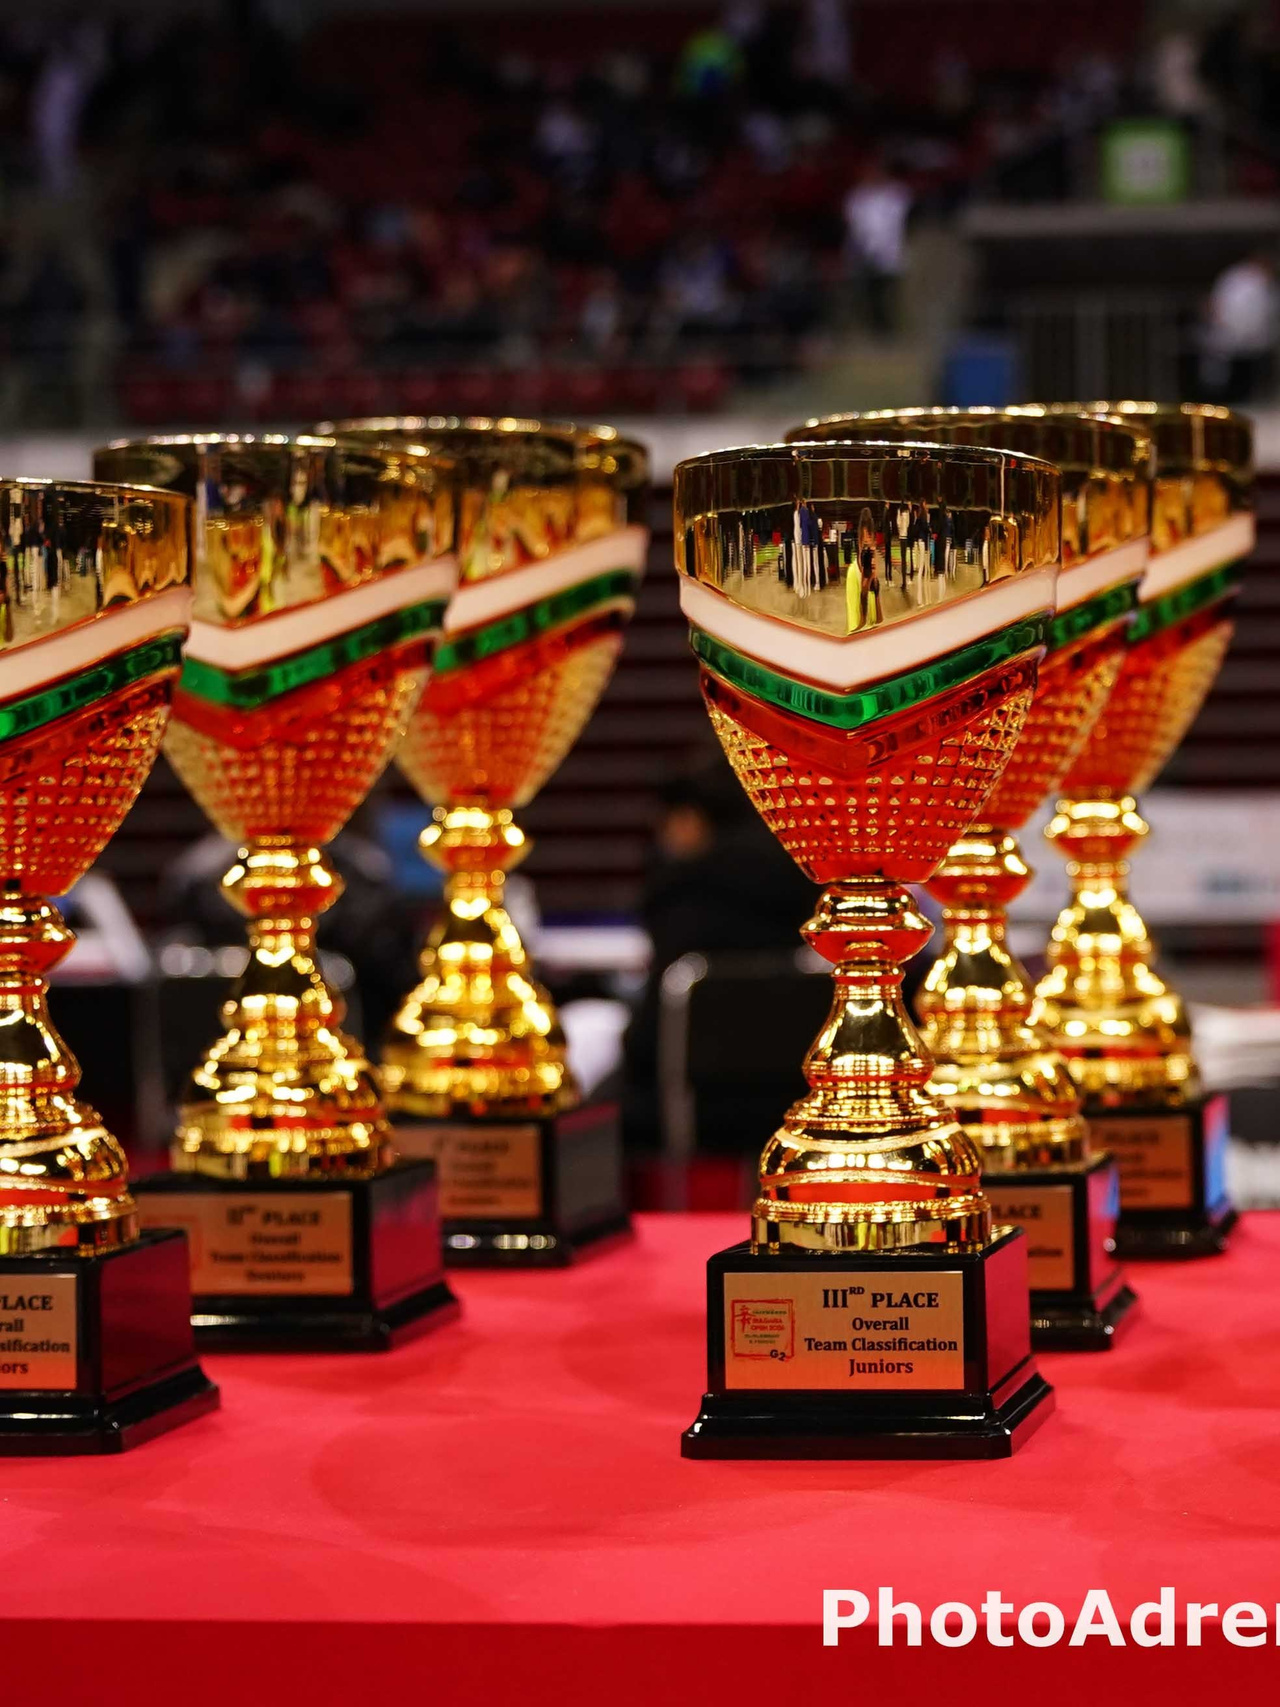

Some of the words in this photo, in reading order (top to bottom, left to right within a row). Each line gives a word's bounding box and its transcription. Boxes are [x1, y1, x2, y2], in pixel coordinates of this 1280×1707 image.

[0, 1295, 53, 1311] LACE
[871, 1292, 939, 1308] PLACE
[852, 1316, 909, 1331] Overall
[804, 1337, 847, 1351] Team
[851, 1337, 958, 1351] Classification
[770, 1349, 786, 1361] G2
[849, 1359, 914, 1376] Juniors
